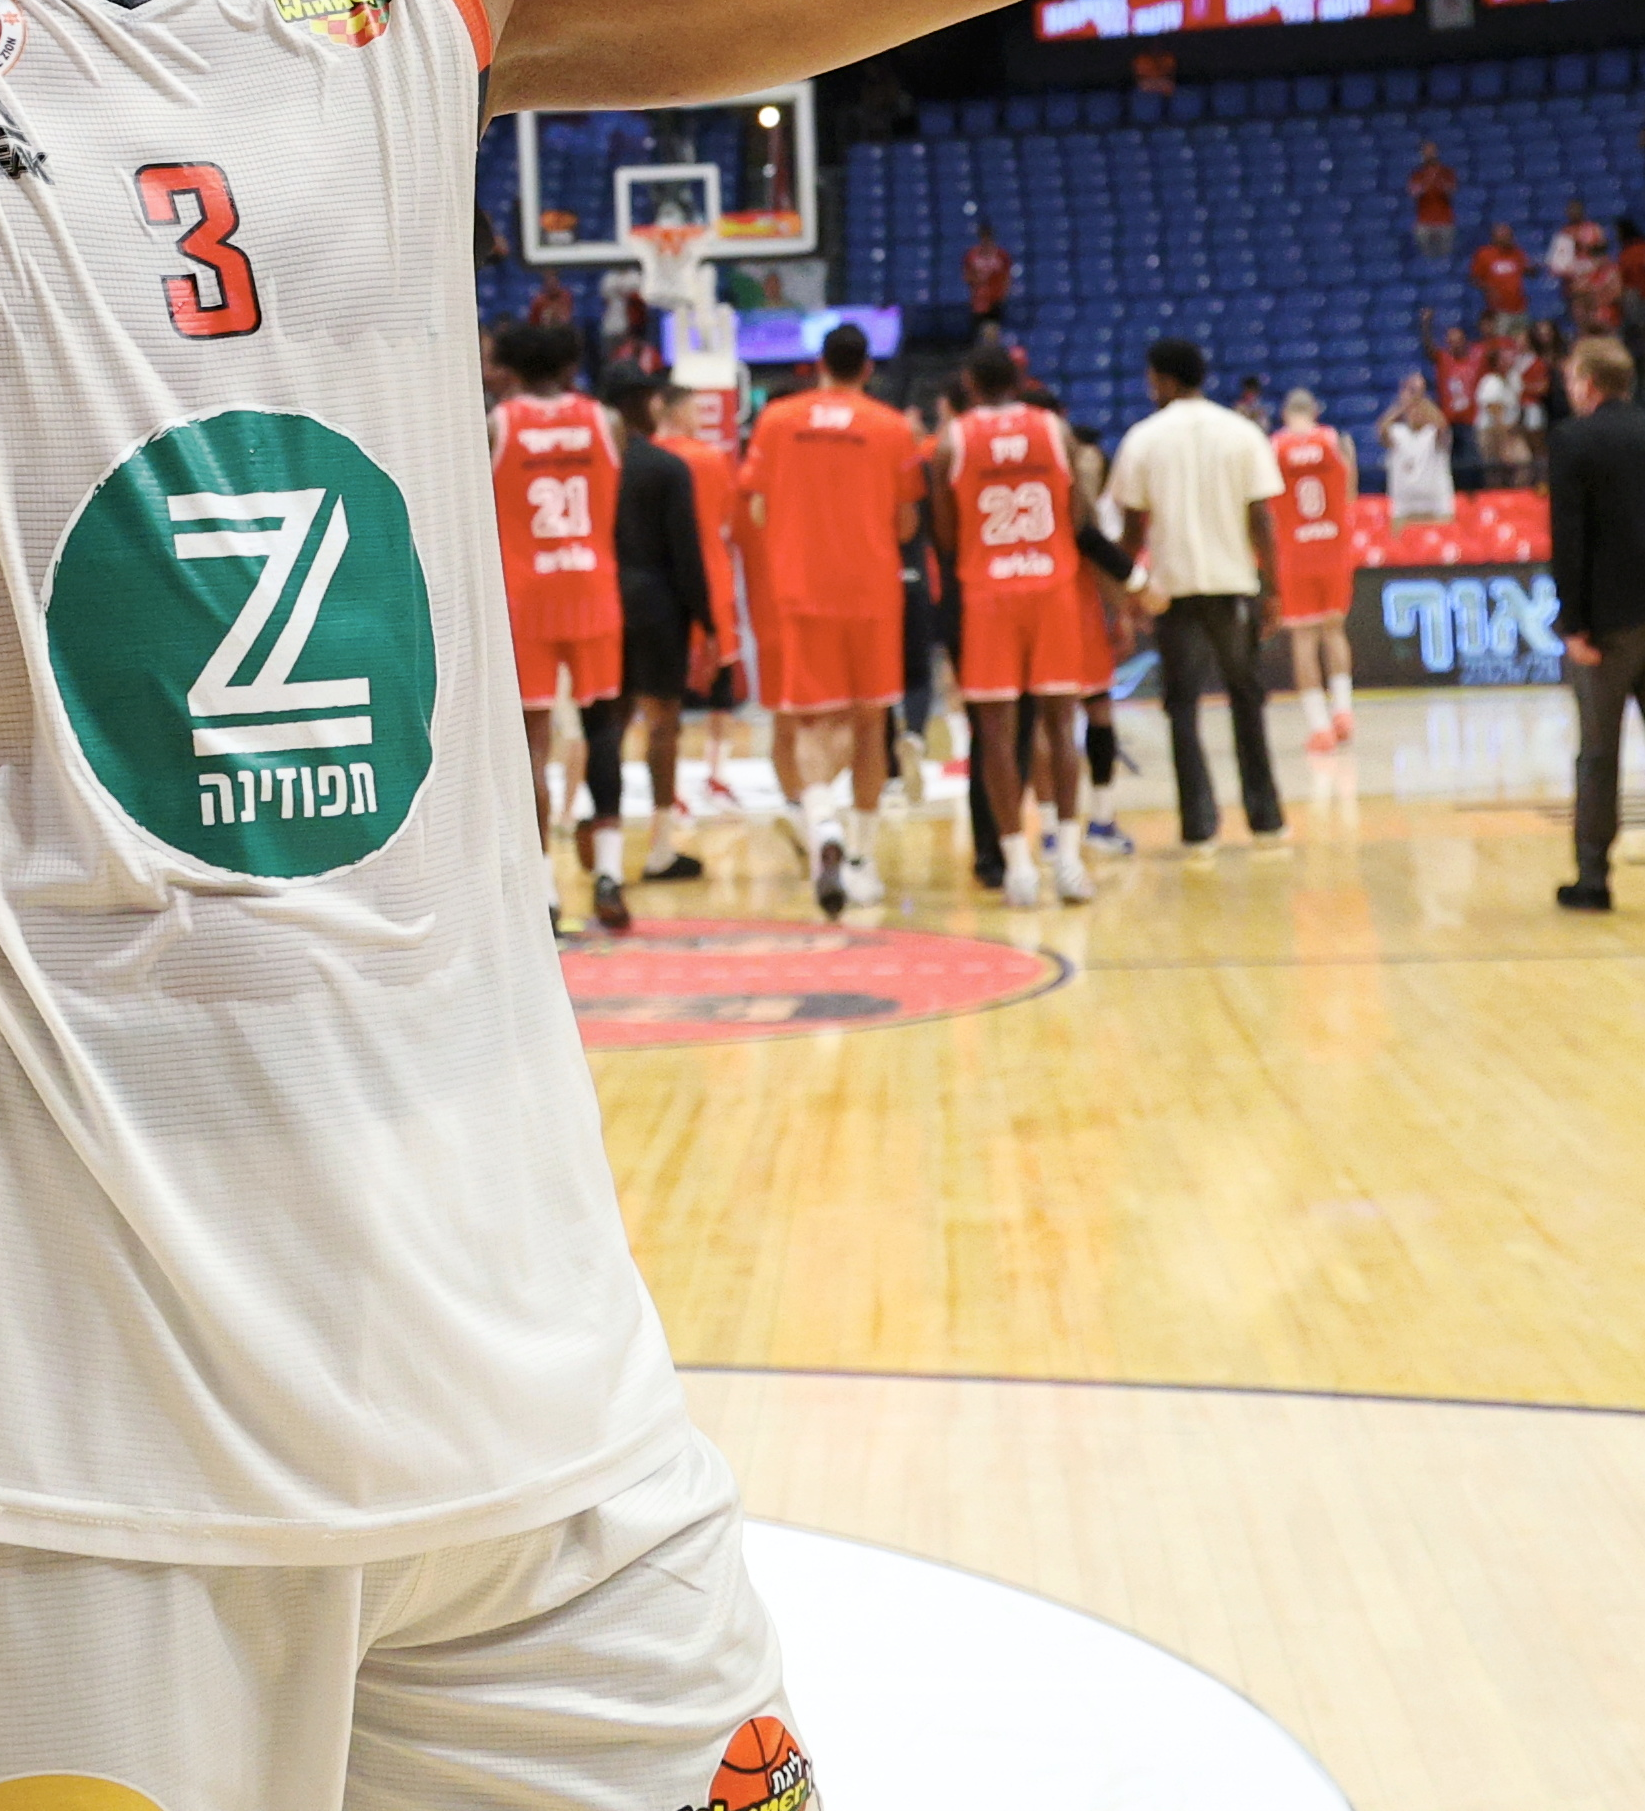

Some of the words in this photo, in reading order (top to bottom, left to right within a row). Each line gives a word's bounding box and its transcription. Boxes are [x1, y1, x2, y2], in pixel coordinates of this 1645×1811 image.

[0, 36, 17, 61] ZION
[133, 160, 263, 342] 3
[526, 474, 593, 540] 21
[977, 482, 1056, 547] 23
[1382, 574, 1566, 674] אוף
[199, 762, 379, 828] תפוזינה
